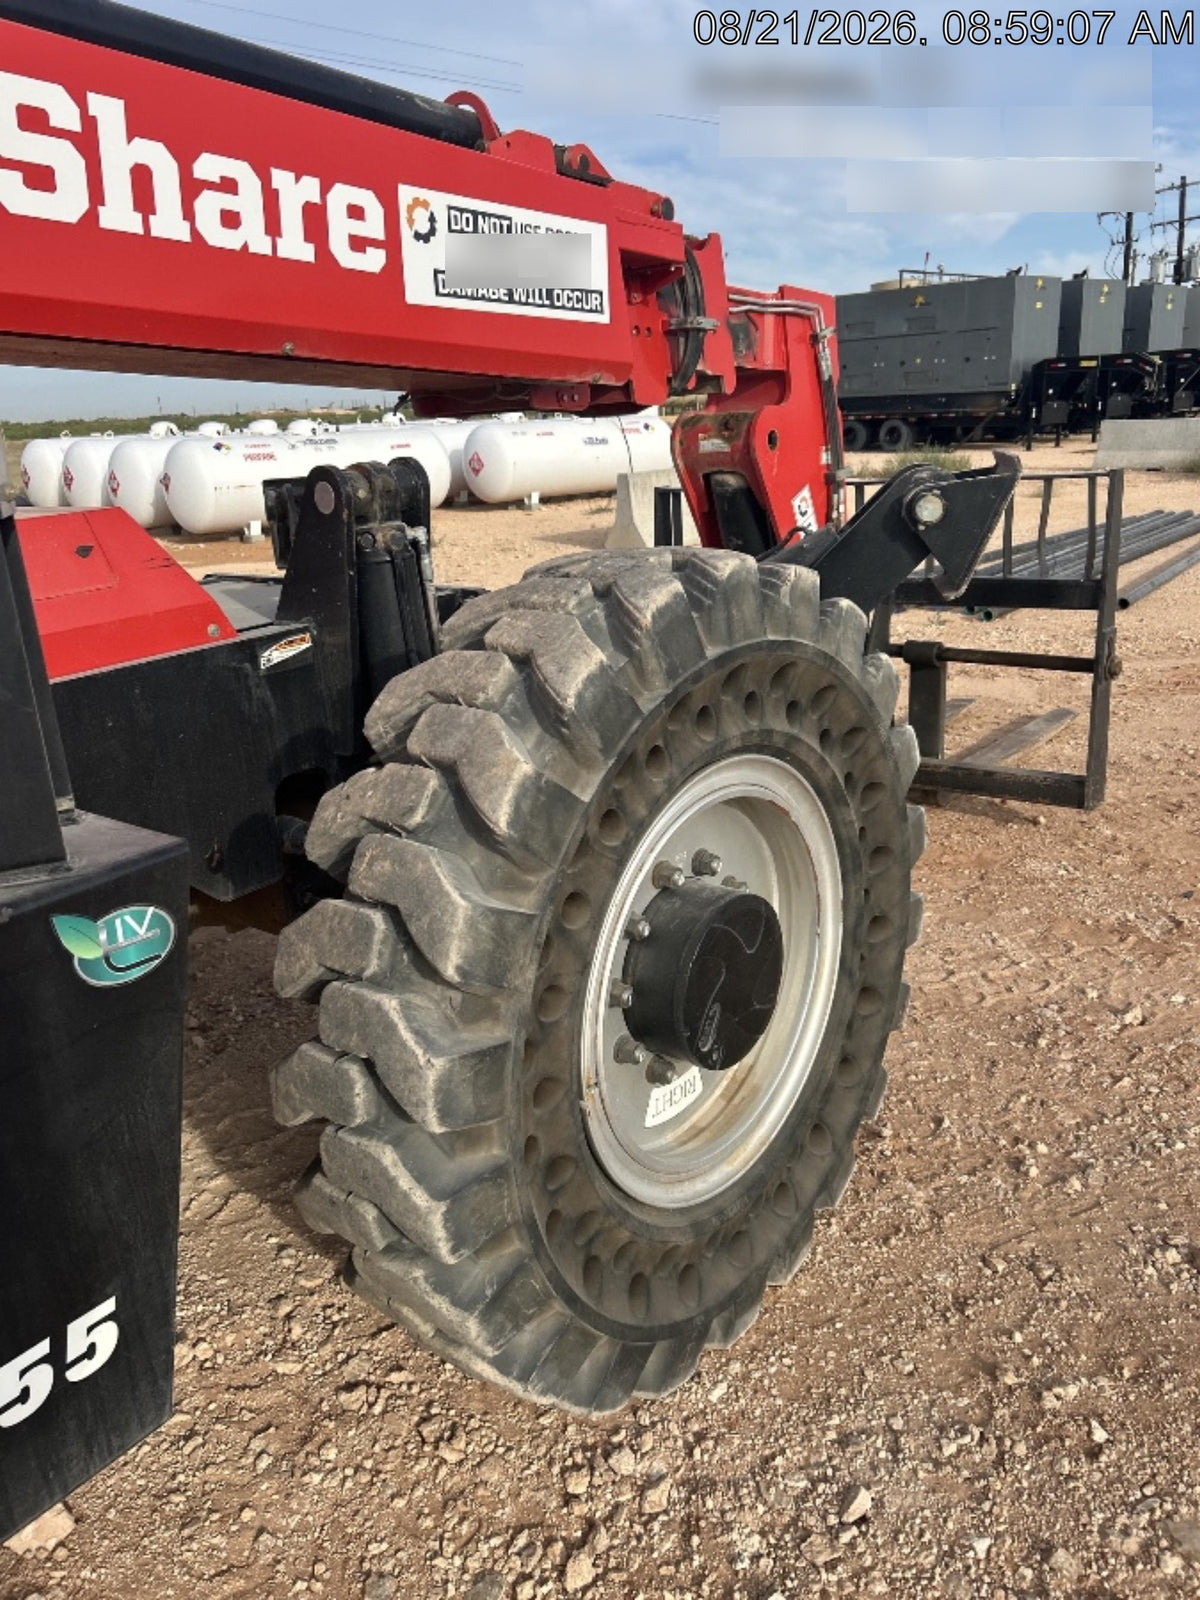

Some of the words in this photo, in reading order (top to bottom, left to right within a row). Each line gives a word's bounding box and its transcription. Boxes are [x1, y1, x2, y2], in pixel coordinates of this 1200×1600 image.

[0, 70, 387, 274] Share
[450, 209, 473, 231] DO
[478, 215, 511, 234] NOT
[513, 286, 550, 305] WILL
[554, 289, 602, 311] OCCUR
[651, 1074, 696, 1119] RIGHT
